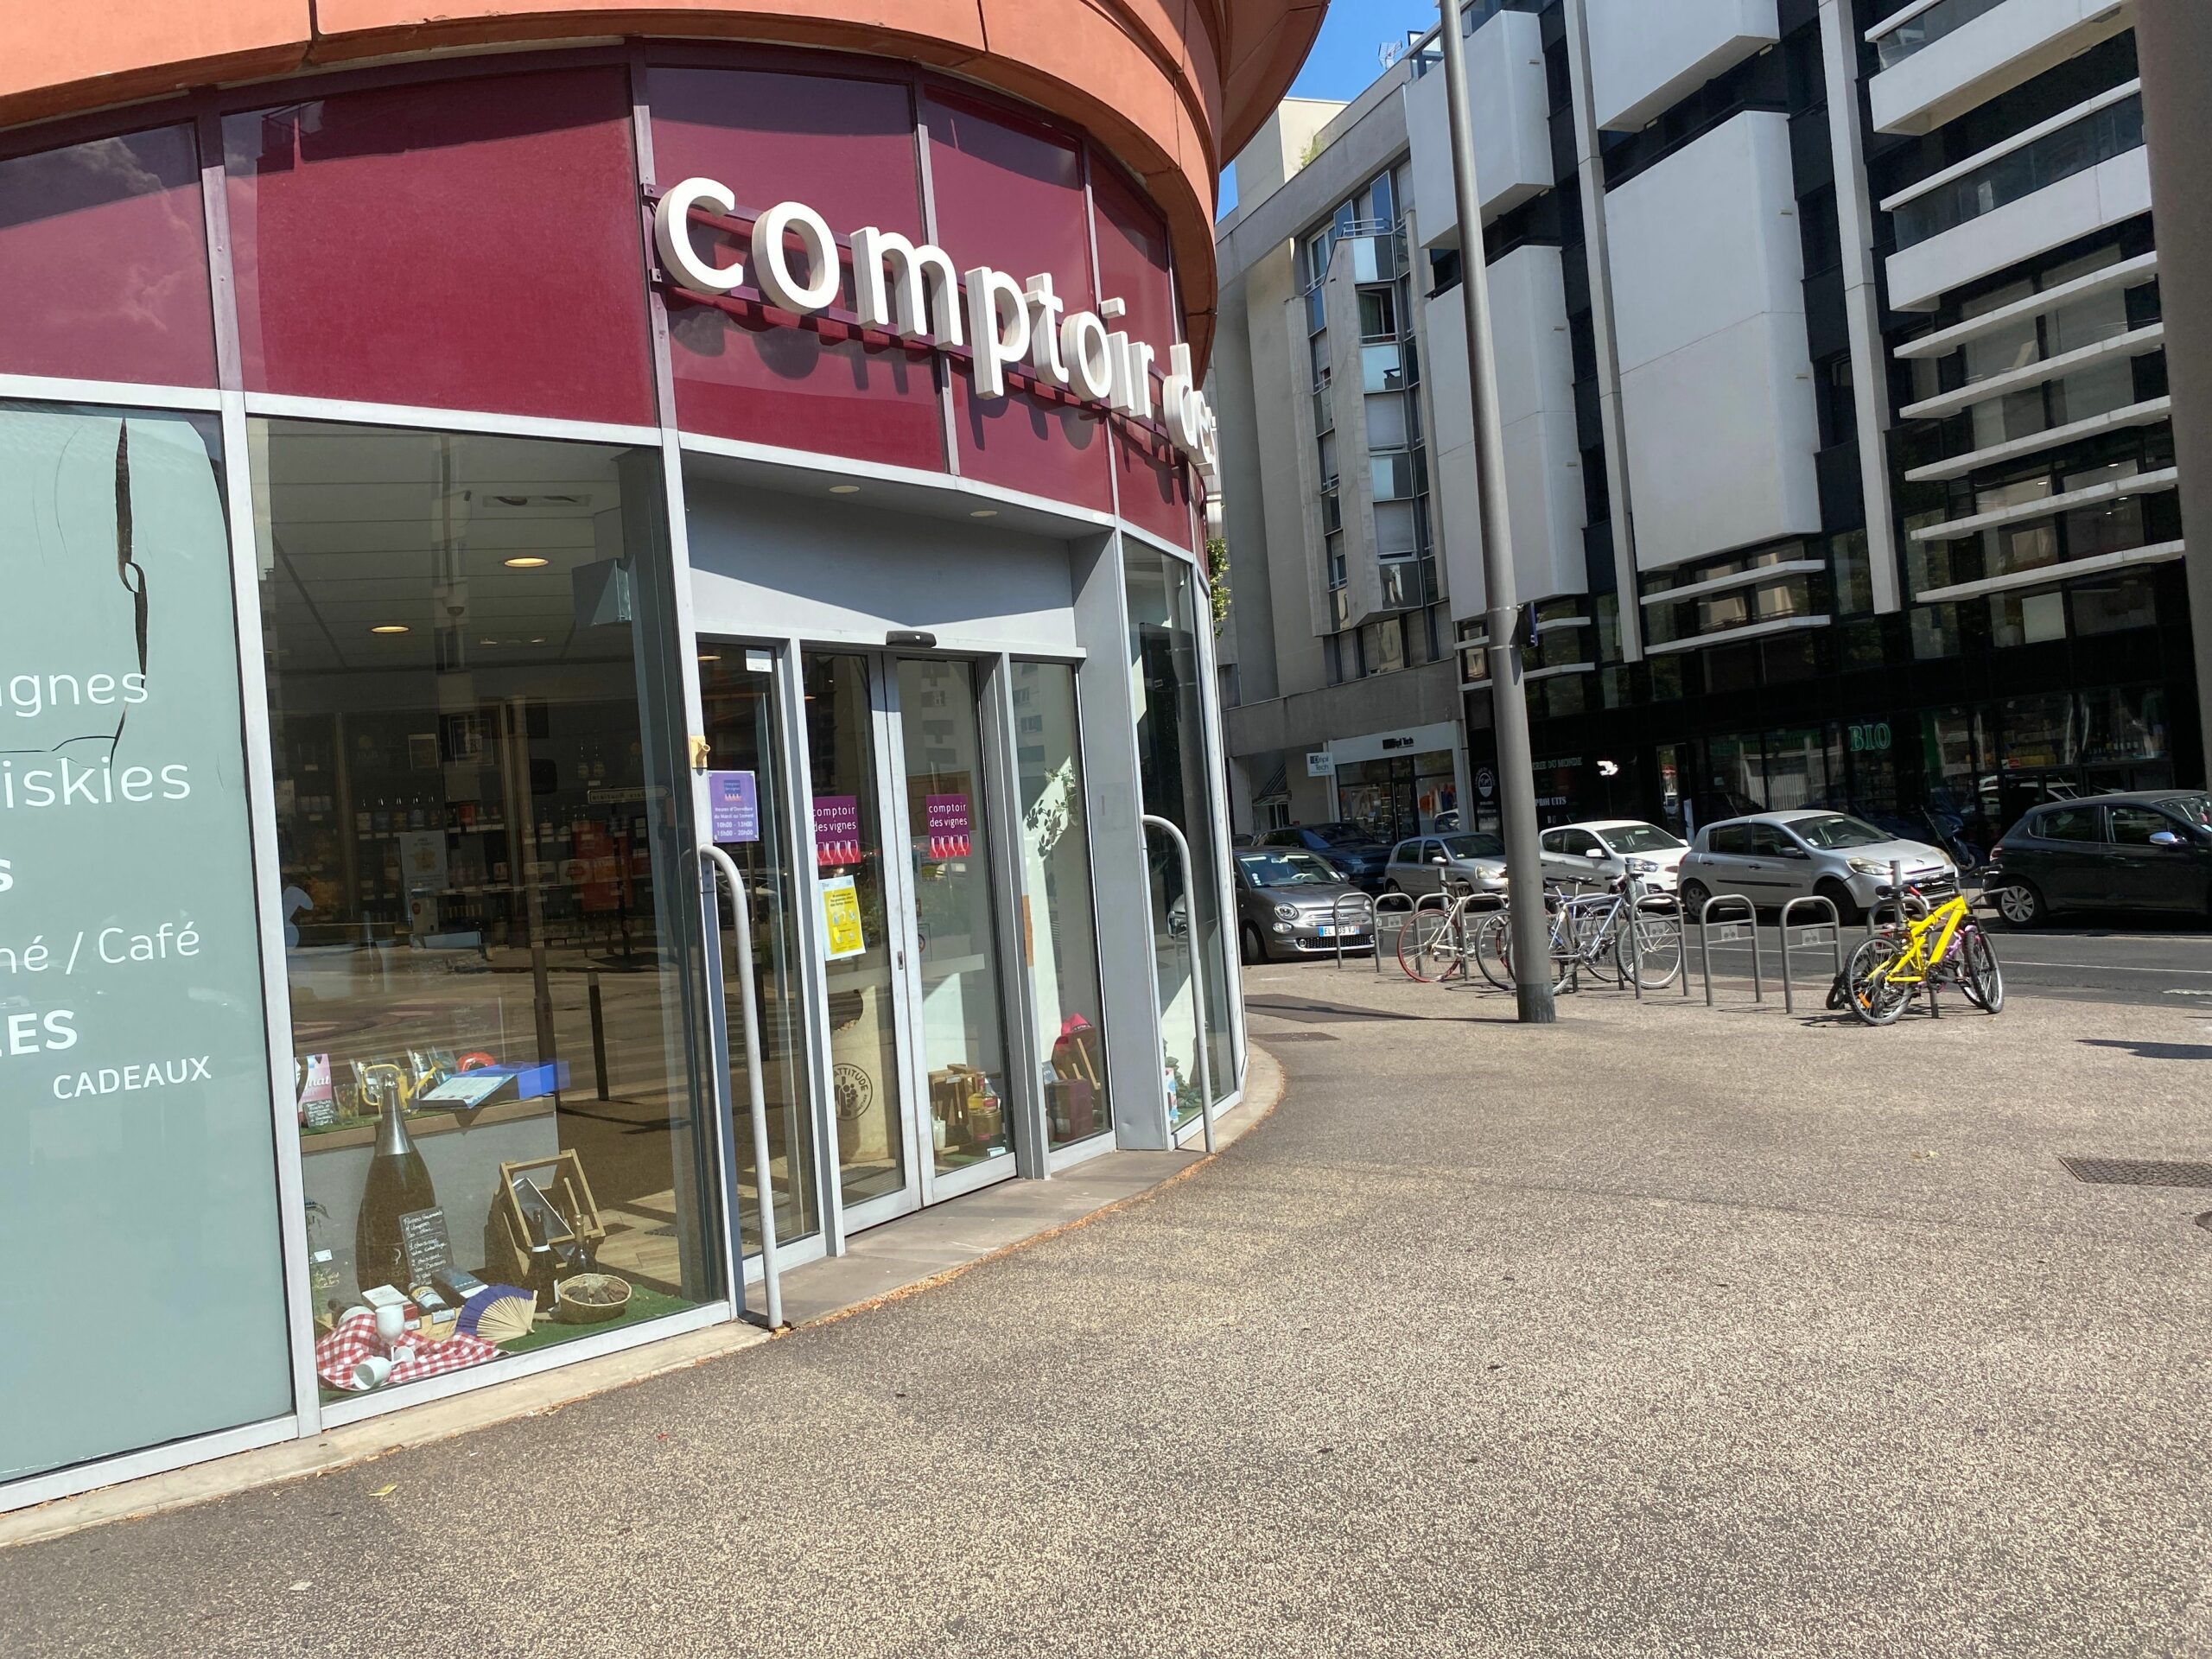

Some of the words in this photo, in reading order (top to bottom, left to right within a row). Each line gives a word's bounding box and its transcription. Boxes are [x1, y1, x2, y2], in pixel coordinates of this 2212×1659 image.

[654, 177, 1154, 420] comptoir
[0, 672, 149, 717] gnes
[1848, 722, 1891, 752] BIO
[830, 820, 856, 834] vignes
[929, 802, 966, 815] comptoir
[930, 817, 943, 828] des
[944, 817, 968, 829] vignes
[99, 921, 200, 963] Café
[0, 1009, 78, 1057] ES
[53, 1055, 212, 1100] CADEAUX
